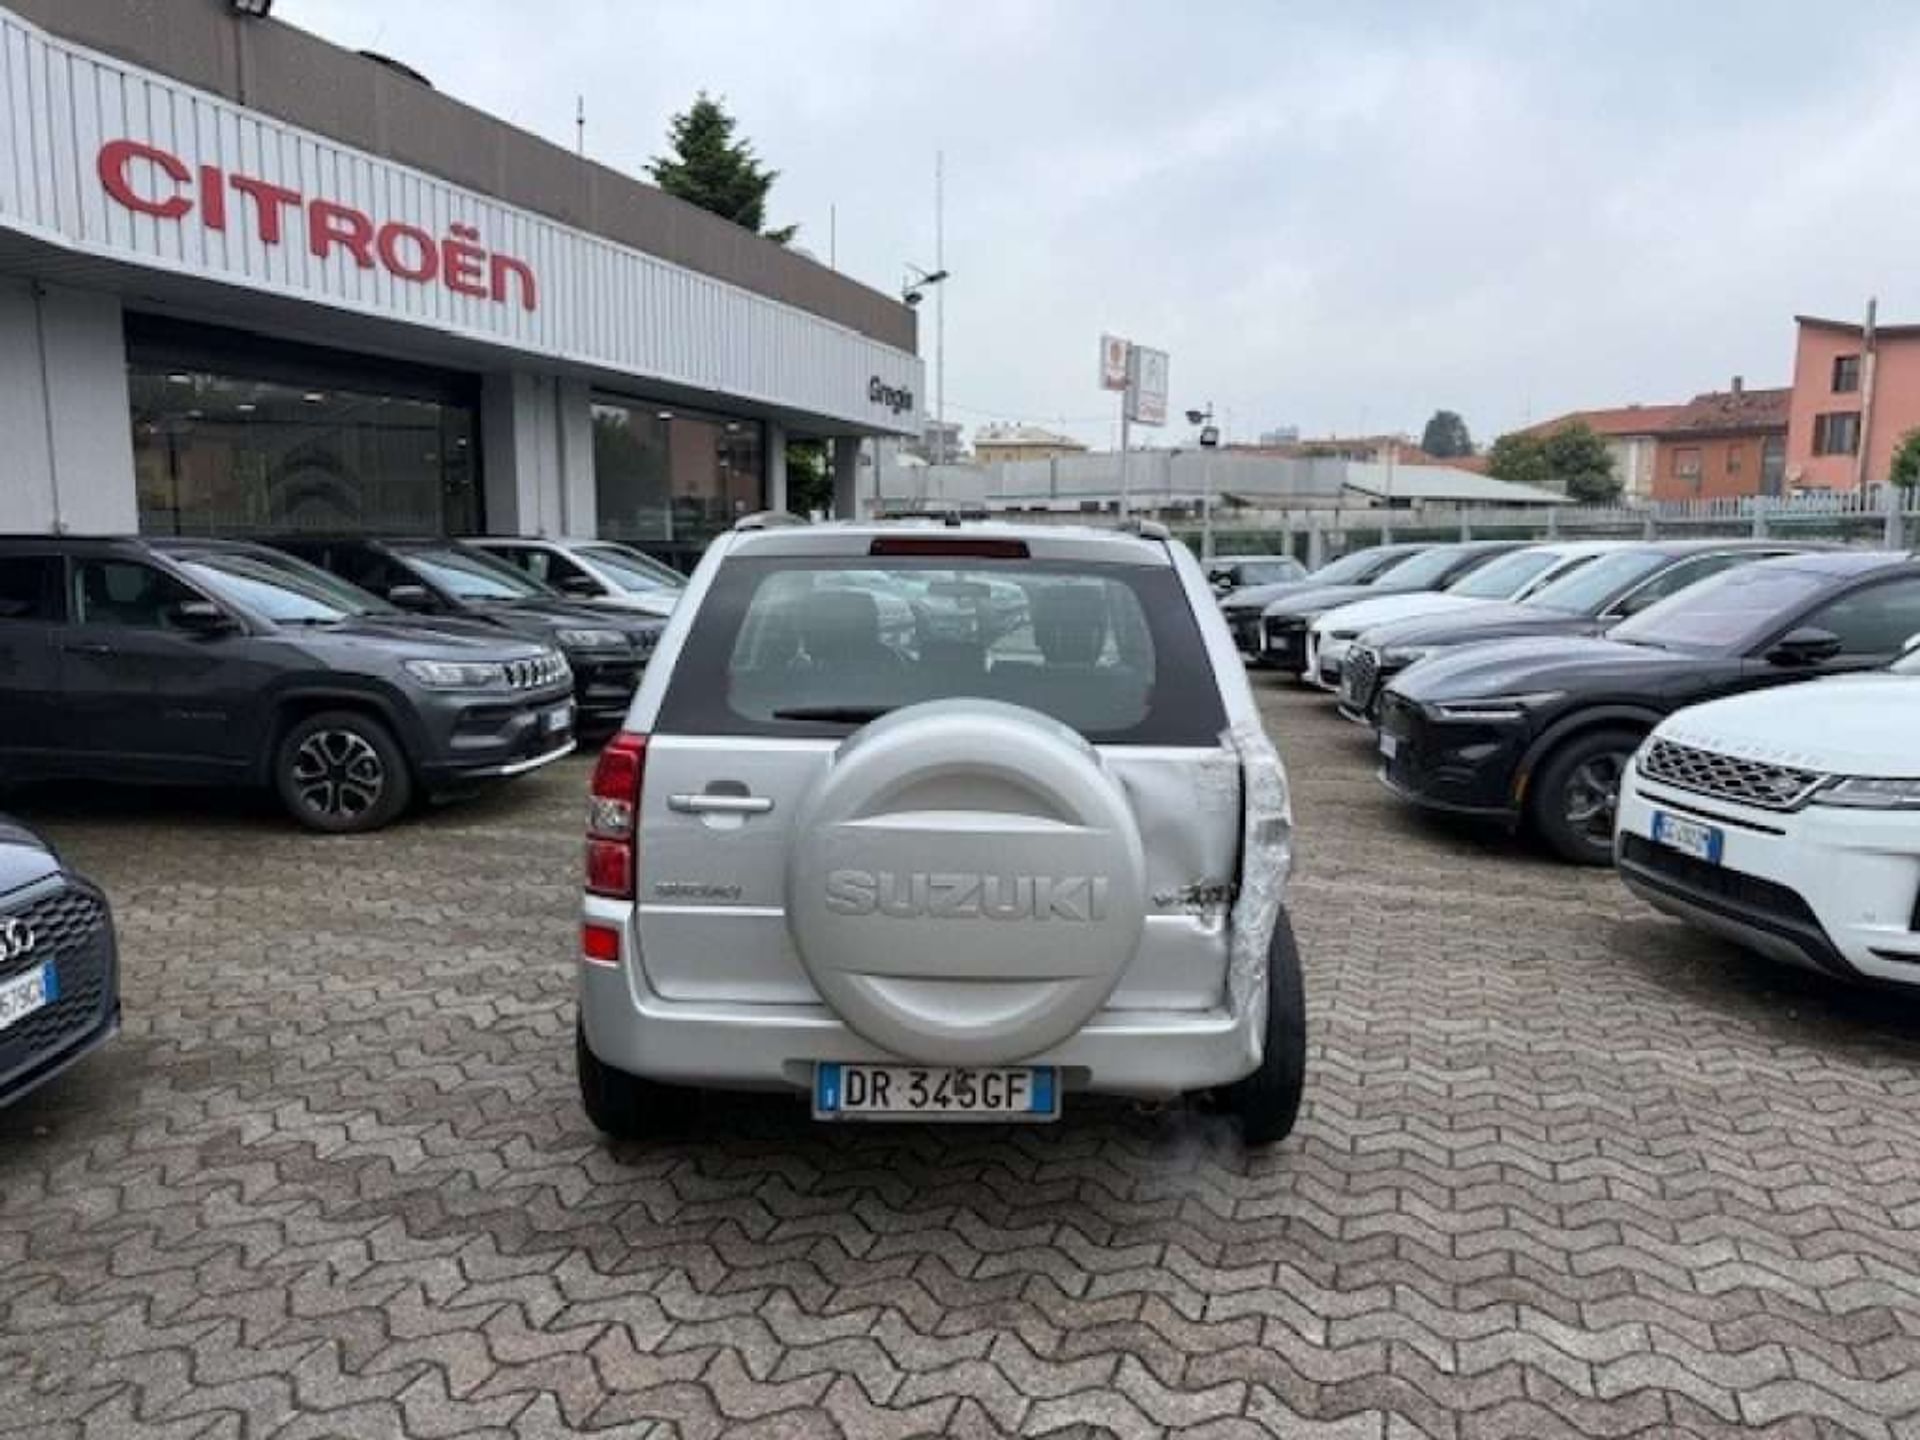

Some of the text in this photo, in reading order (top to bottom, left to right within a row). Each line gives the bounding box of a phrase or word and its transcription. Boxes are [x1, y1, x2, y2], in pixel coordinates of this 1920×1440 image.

[825, 870, 1109, 921] SUZUKI
[846, 1070, 892, 1106] DR
[908, 1070, 1027, 1109] 345GF
